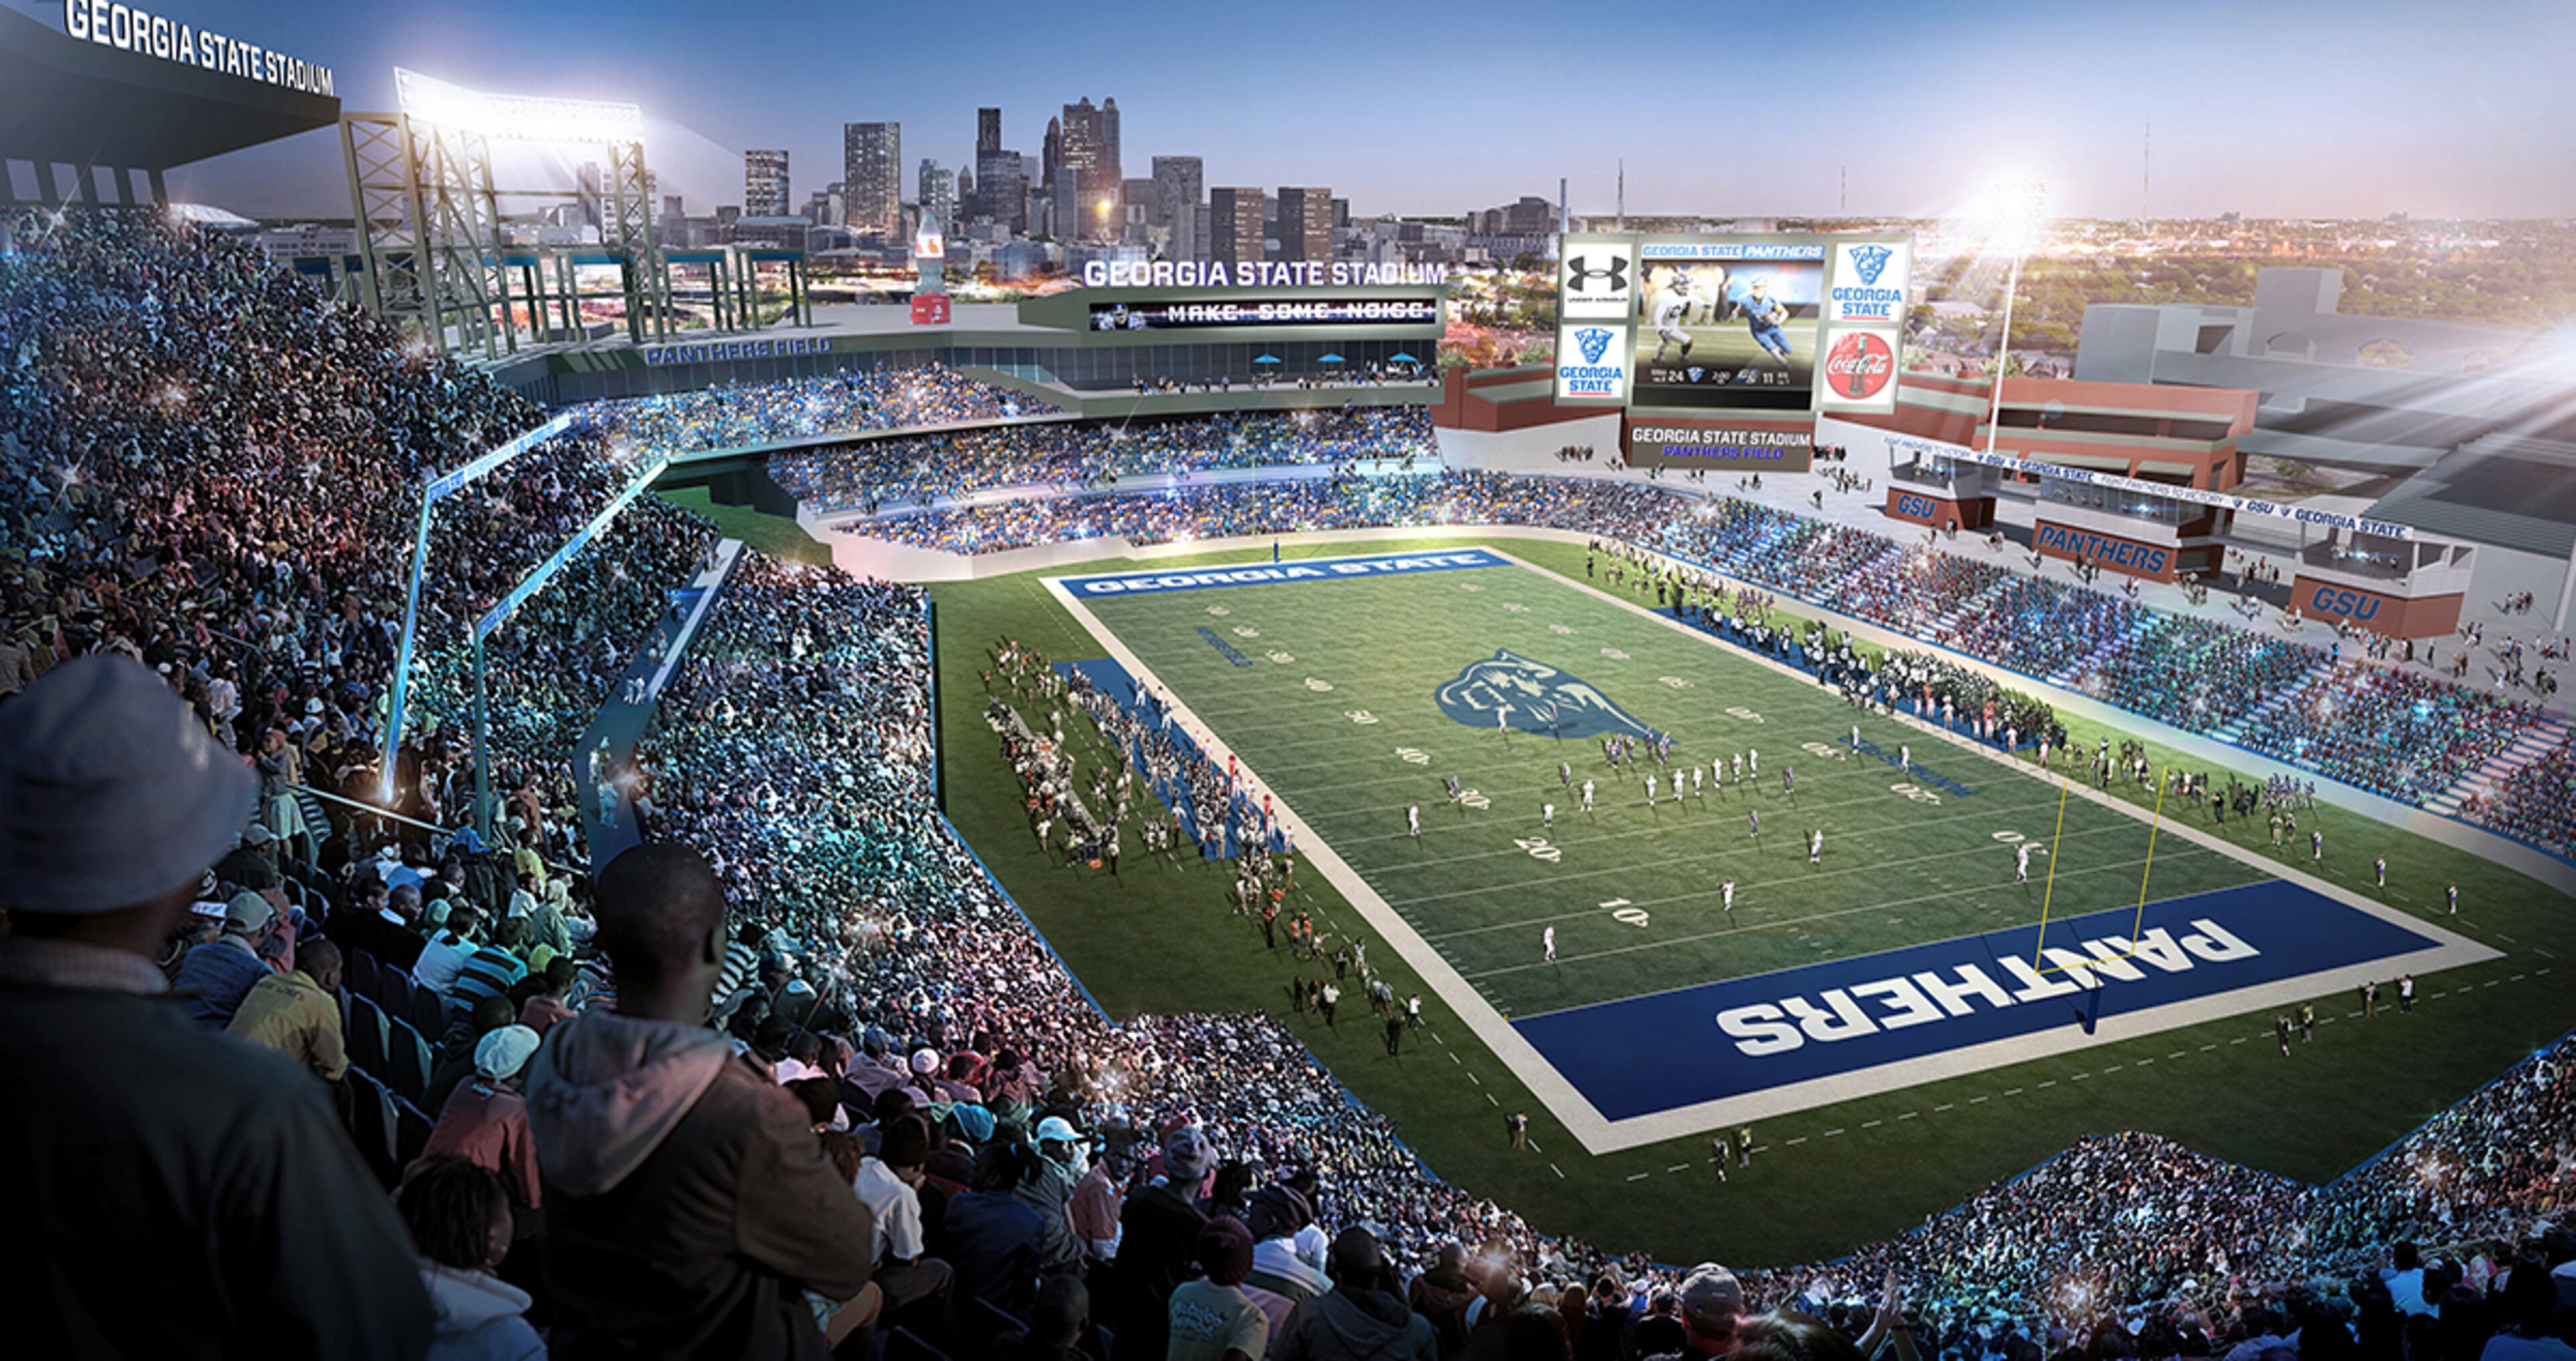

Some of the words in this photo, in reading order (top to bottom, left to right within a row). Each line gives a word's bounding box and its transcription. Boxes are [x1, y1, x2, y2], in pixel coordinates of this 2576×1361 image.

[65, 0, 195, 65] GEORGIA
[199, 30, 265, 83] STATE
[266, 52, 334, 97] STADIUM
[1642, 246, 1698, 257] GEORGIA
[1701, 246, 1742, 257] STATE
[1744, 246, 1822, 258] PANTHERS
[1083, 261, 1229, 287] GEORGIA
[1236, 261, 1326, 286] STATE
[1331, 262, 1445, 285] STADIUM
[1832, 287, 1902, 302] GEORGIA
[1167, 305, 1238, 323] MAKE
[1257, 305, 1328, 321] SOME
[1346, 303, 1424, 320] NOISE
[1841, 303, 1891, 317] STATE
[644, 340, 771, 366] PANTHERS
[773, 337, 832, 356] FIELD
[1559, 366, 1623, 379] GEORGIA
[1568, 380, 1613, 392] STATE
[1632, 427, 1700, 444] GEORGIA
[1703, 431, 1747, 445] STATE
[1750, 433, 1811, 446] STADIUM
[1662, 445, 1740, 459] PANTHERS
[1743, 447, 1784, 459] FIELD
[1898, 494, 1936, 519] GSU
[1986, 455, 2004, 466] GSU
[2019, 459, 2061, 476] GEORGIA
[2063, 469, 2094, 483] STATE
[2247, 499, 2274, 515] GSU
[2295, 508, 2356, 530] GEORGIA
[2359, 519, 2406, 537] STATE
[2038, 525, 2166, 573] PANTHERS
[1085, 567, 1324, 593] GEORGIA
[1330, 553, 1487, 574] STATE
[2312, 586, 2381, 621] GSU
[1513, 836, 1562, 859] 20
[1599, 897, 1649, 926] 10
[1717, 918, 2261, 1057] PANTHERS
